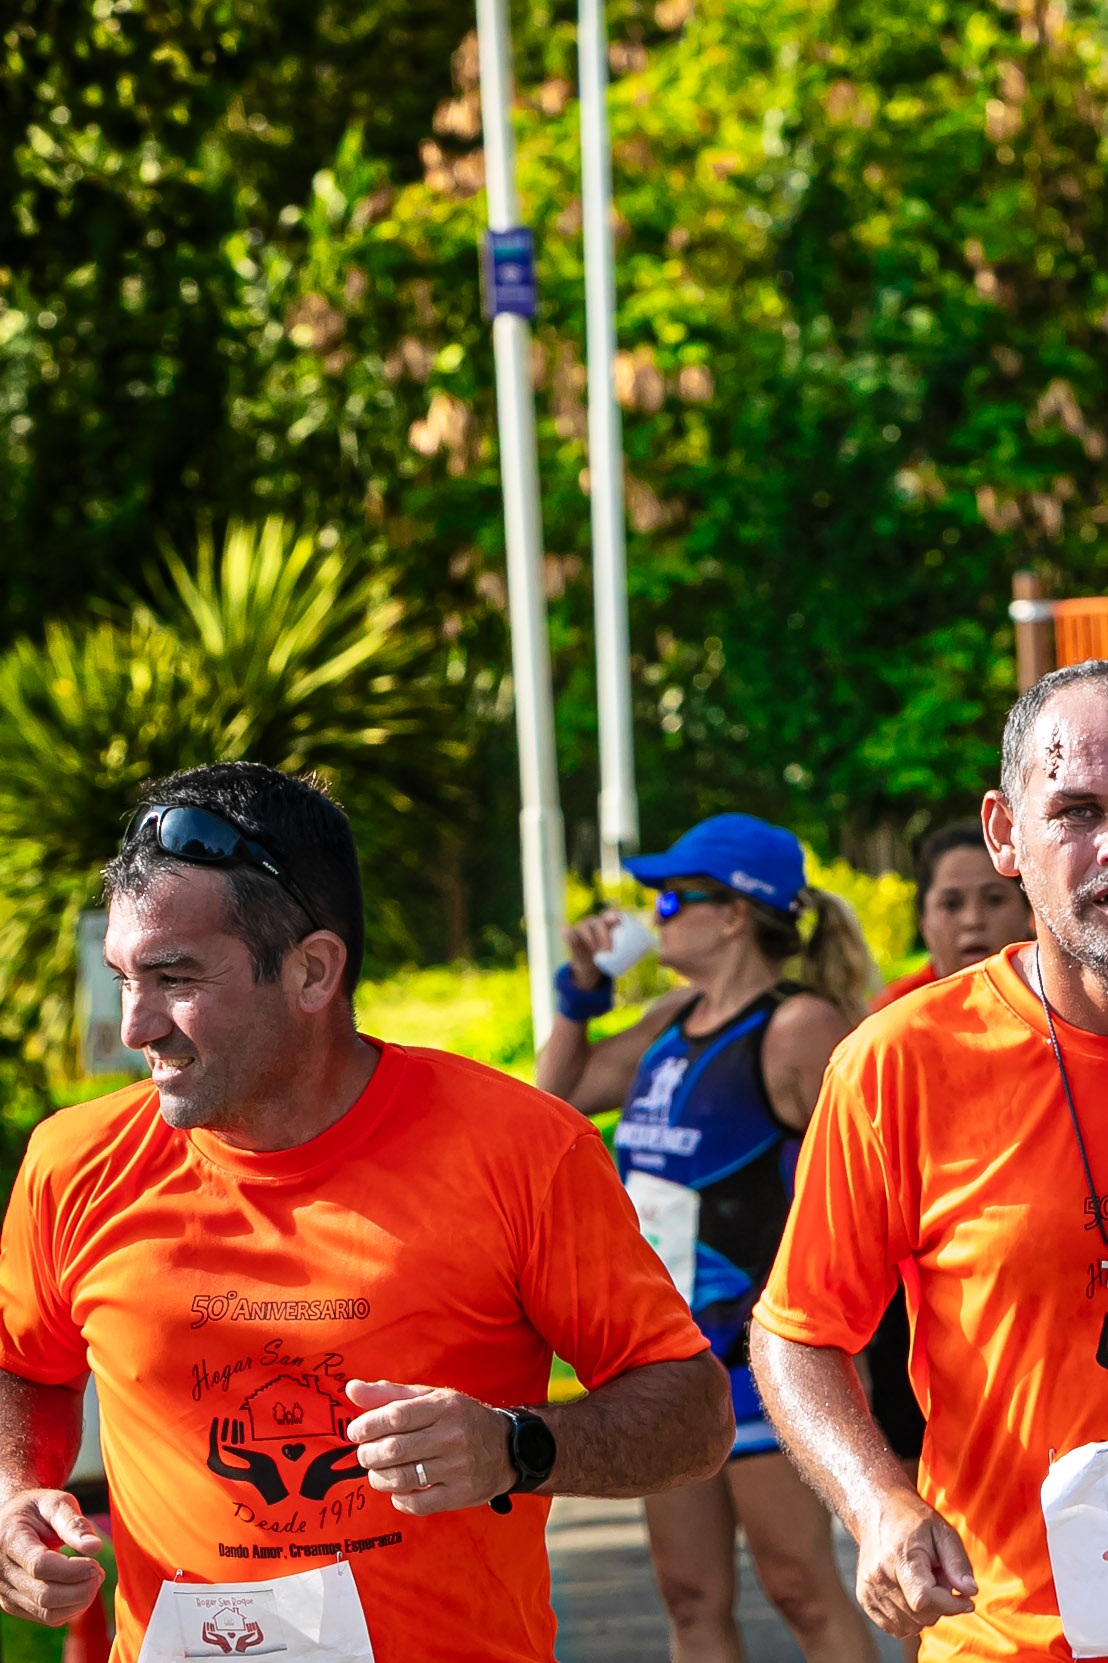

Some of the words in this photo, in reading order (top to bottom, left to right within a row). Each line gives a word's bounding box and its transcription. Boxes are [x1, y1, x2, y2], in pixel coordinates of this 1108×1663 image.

[230, 1297, 371, 1321] ANIVERSARIO
[191, 1356, 253, 1402] Hogar
[260, 1338, 304, 1367] San
[232, 1501, 307, 1534] Desde
[319, 1484, 367, 1529] 1975
[218, 1543, 249, 1559] Dando
[289, 1542, 343, 1557] Creamos
[344, 1531, 402, 1554] Esperanza
